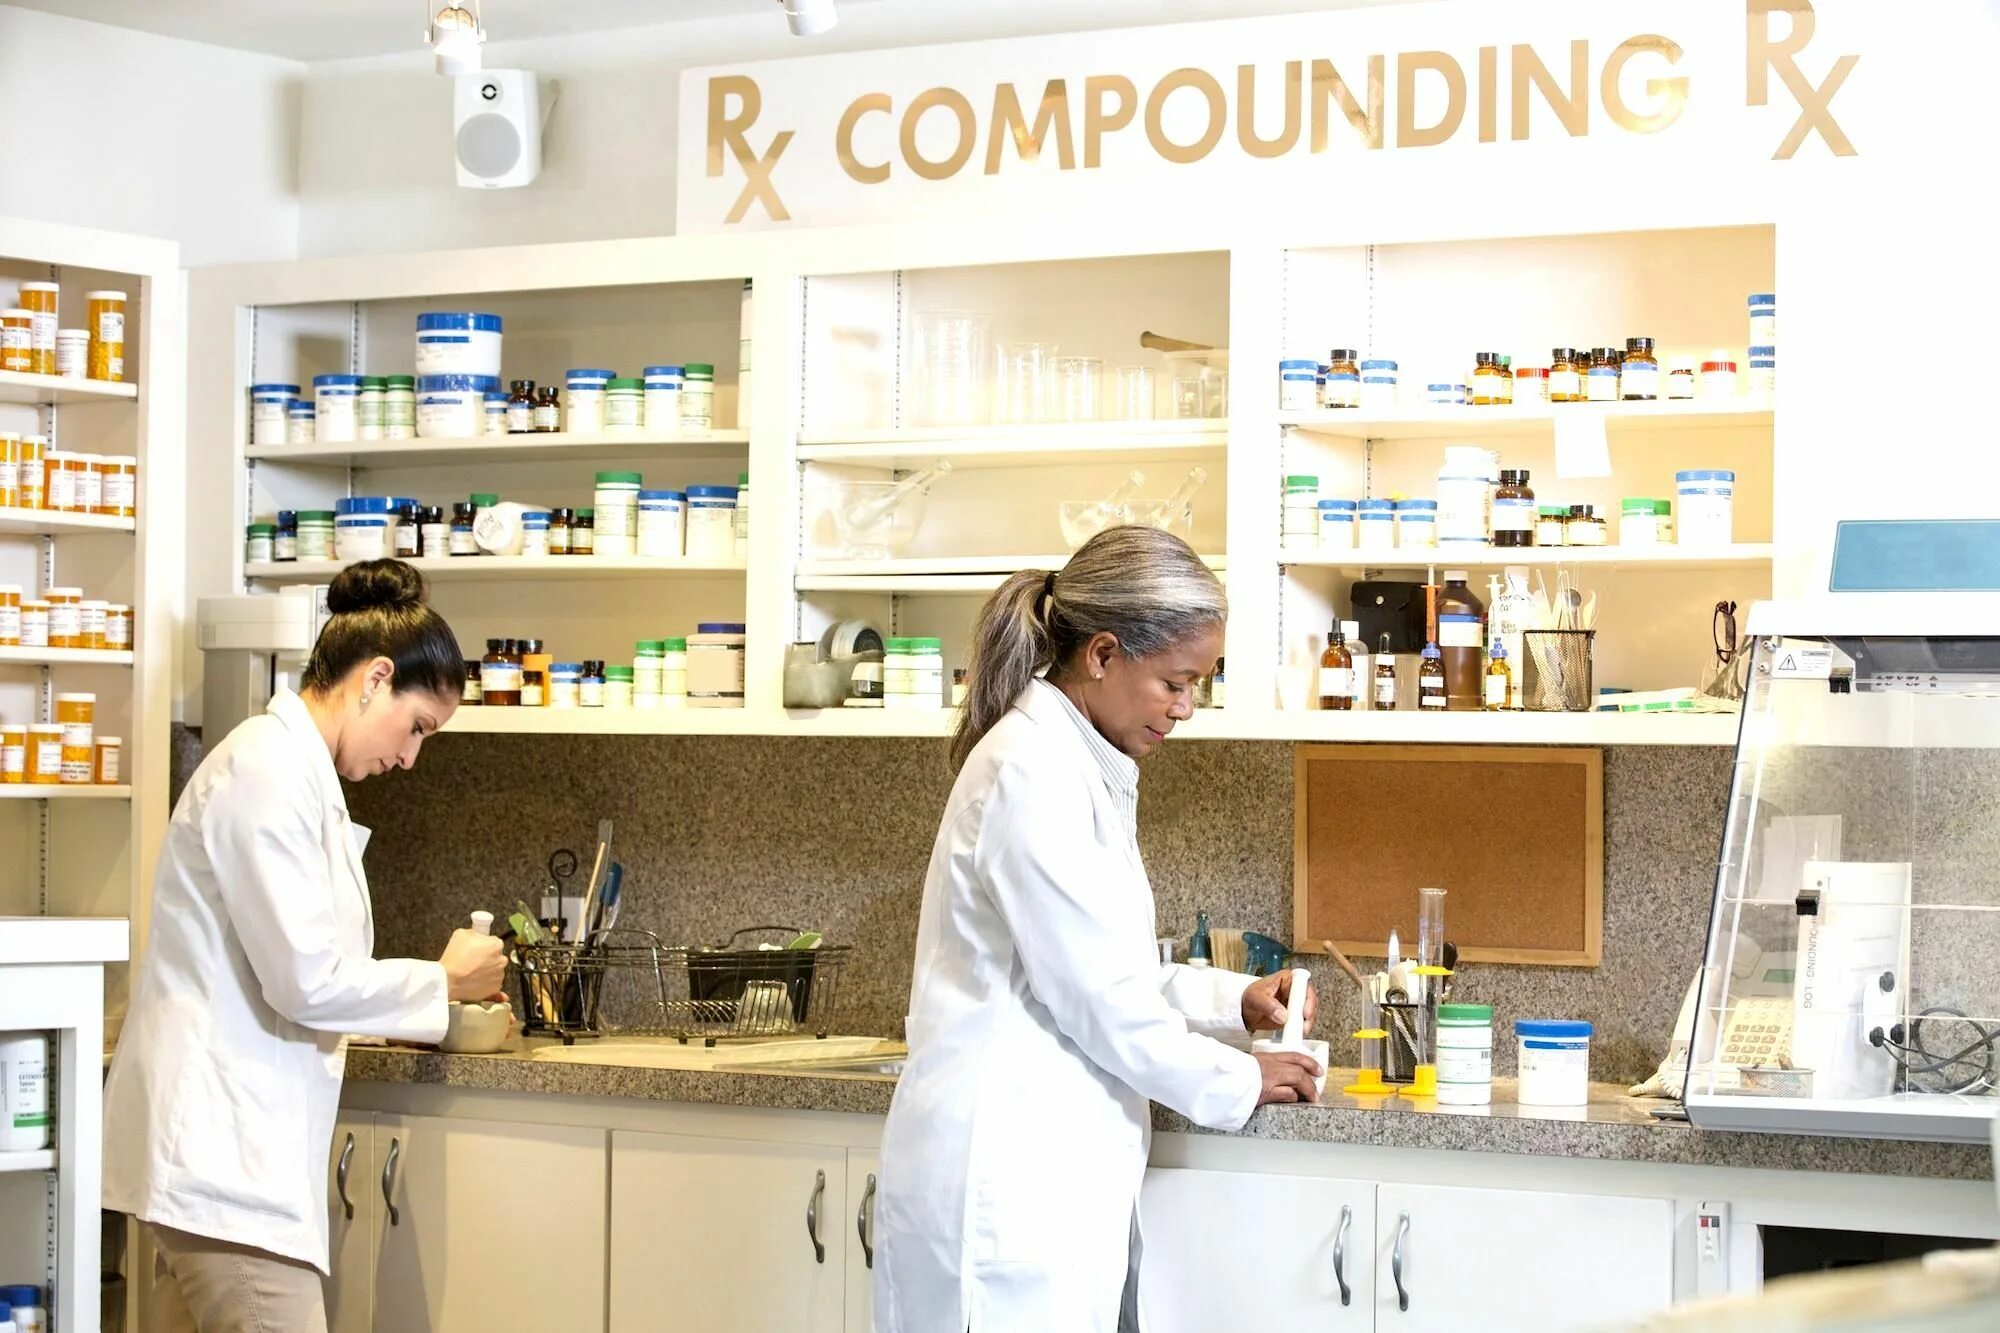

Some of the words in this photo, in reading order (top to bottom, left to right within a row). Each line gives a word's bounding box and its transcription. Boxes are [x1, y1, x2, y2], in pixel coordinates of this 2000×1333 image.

[836, 33, 1689, 184] COMPOUNDING
[1806, 914, 1818, 978] POUNDING
[1803, 986, 1813, 1009] LOG
